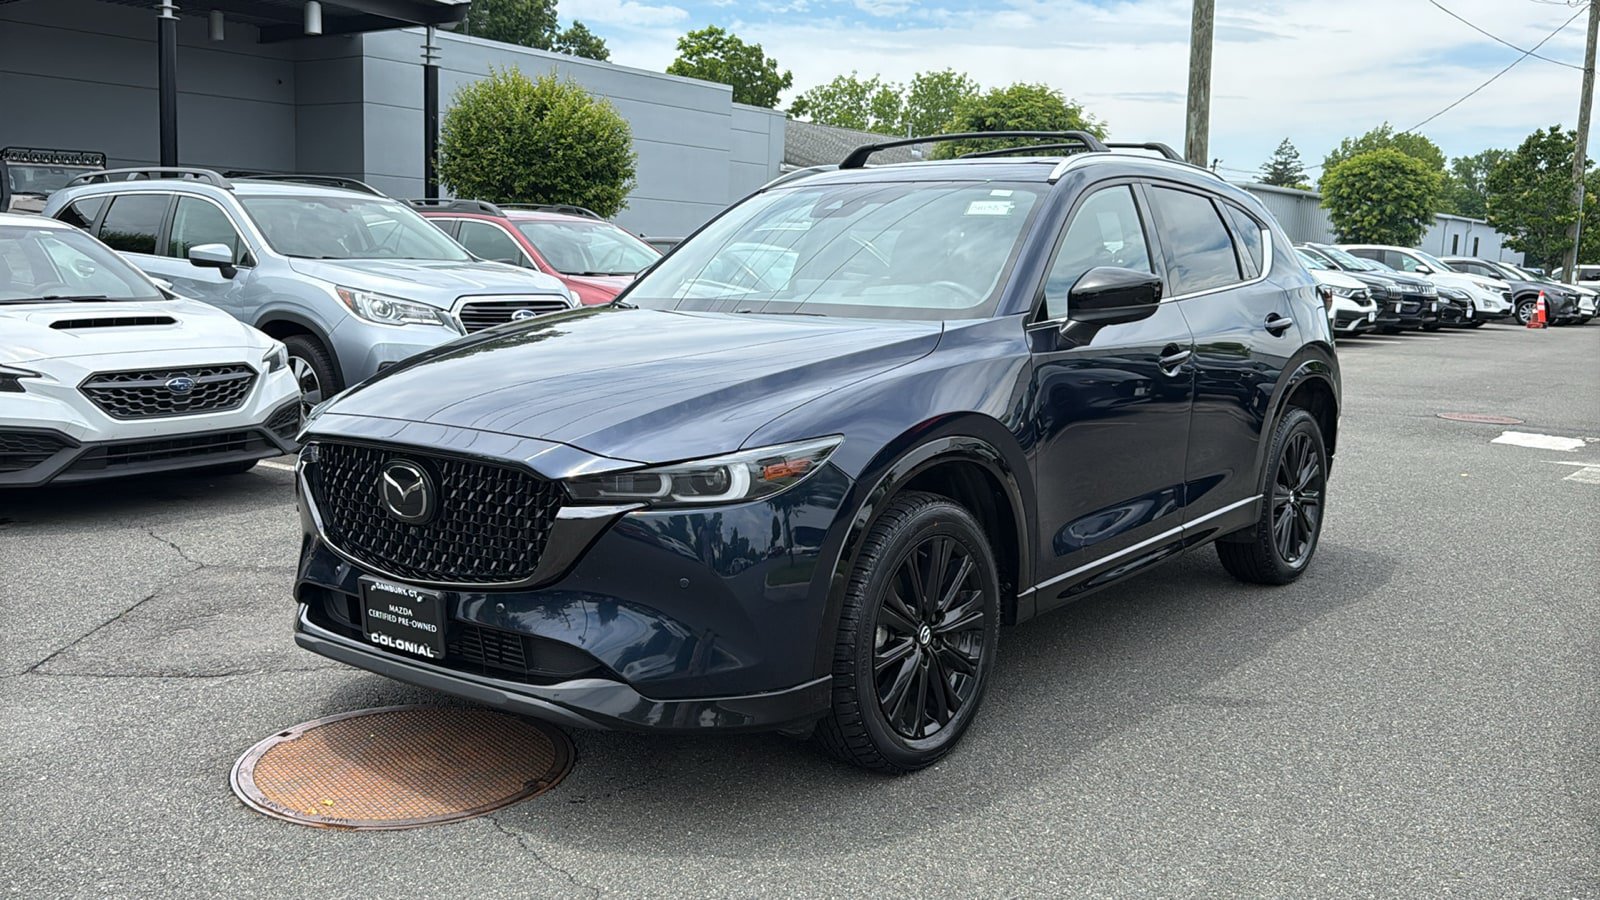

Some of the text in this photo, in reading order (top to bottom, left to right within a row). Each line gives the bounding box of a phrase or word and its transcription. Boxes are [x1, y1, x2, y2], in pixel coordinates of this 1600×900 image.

[368, 609, 437, 632] CERTIFIED PRE-OWNED
[388, 604, 413, 617] MAZDA
[371, 633, 434, 658] COLONIAL
